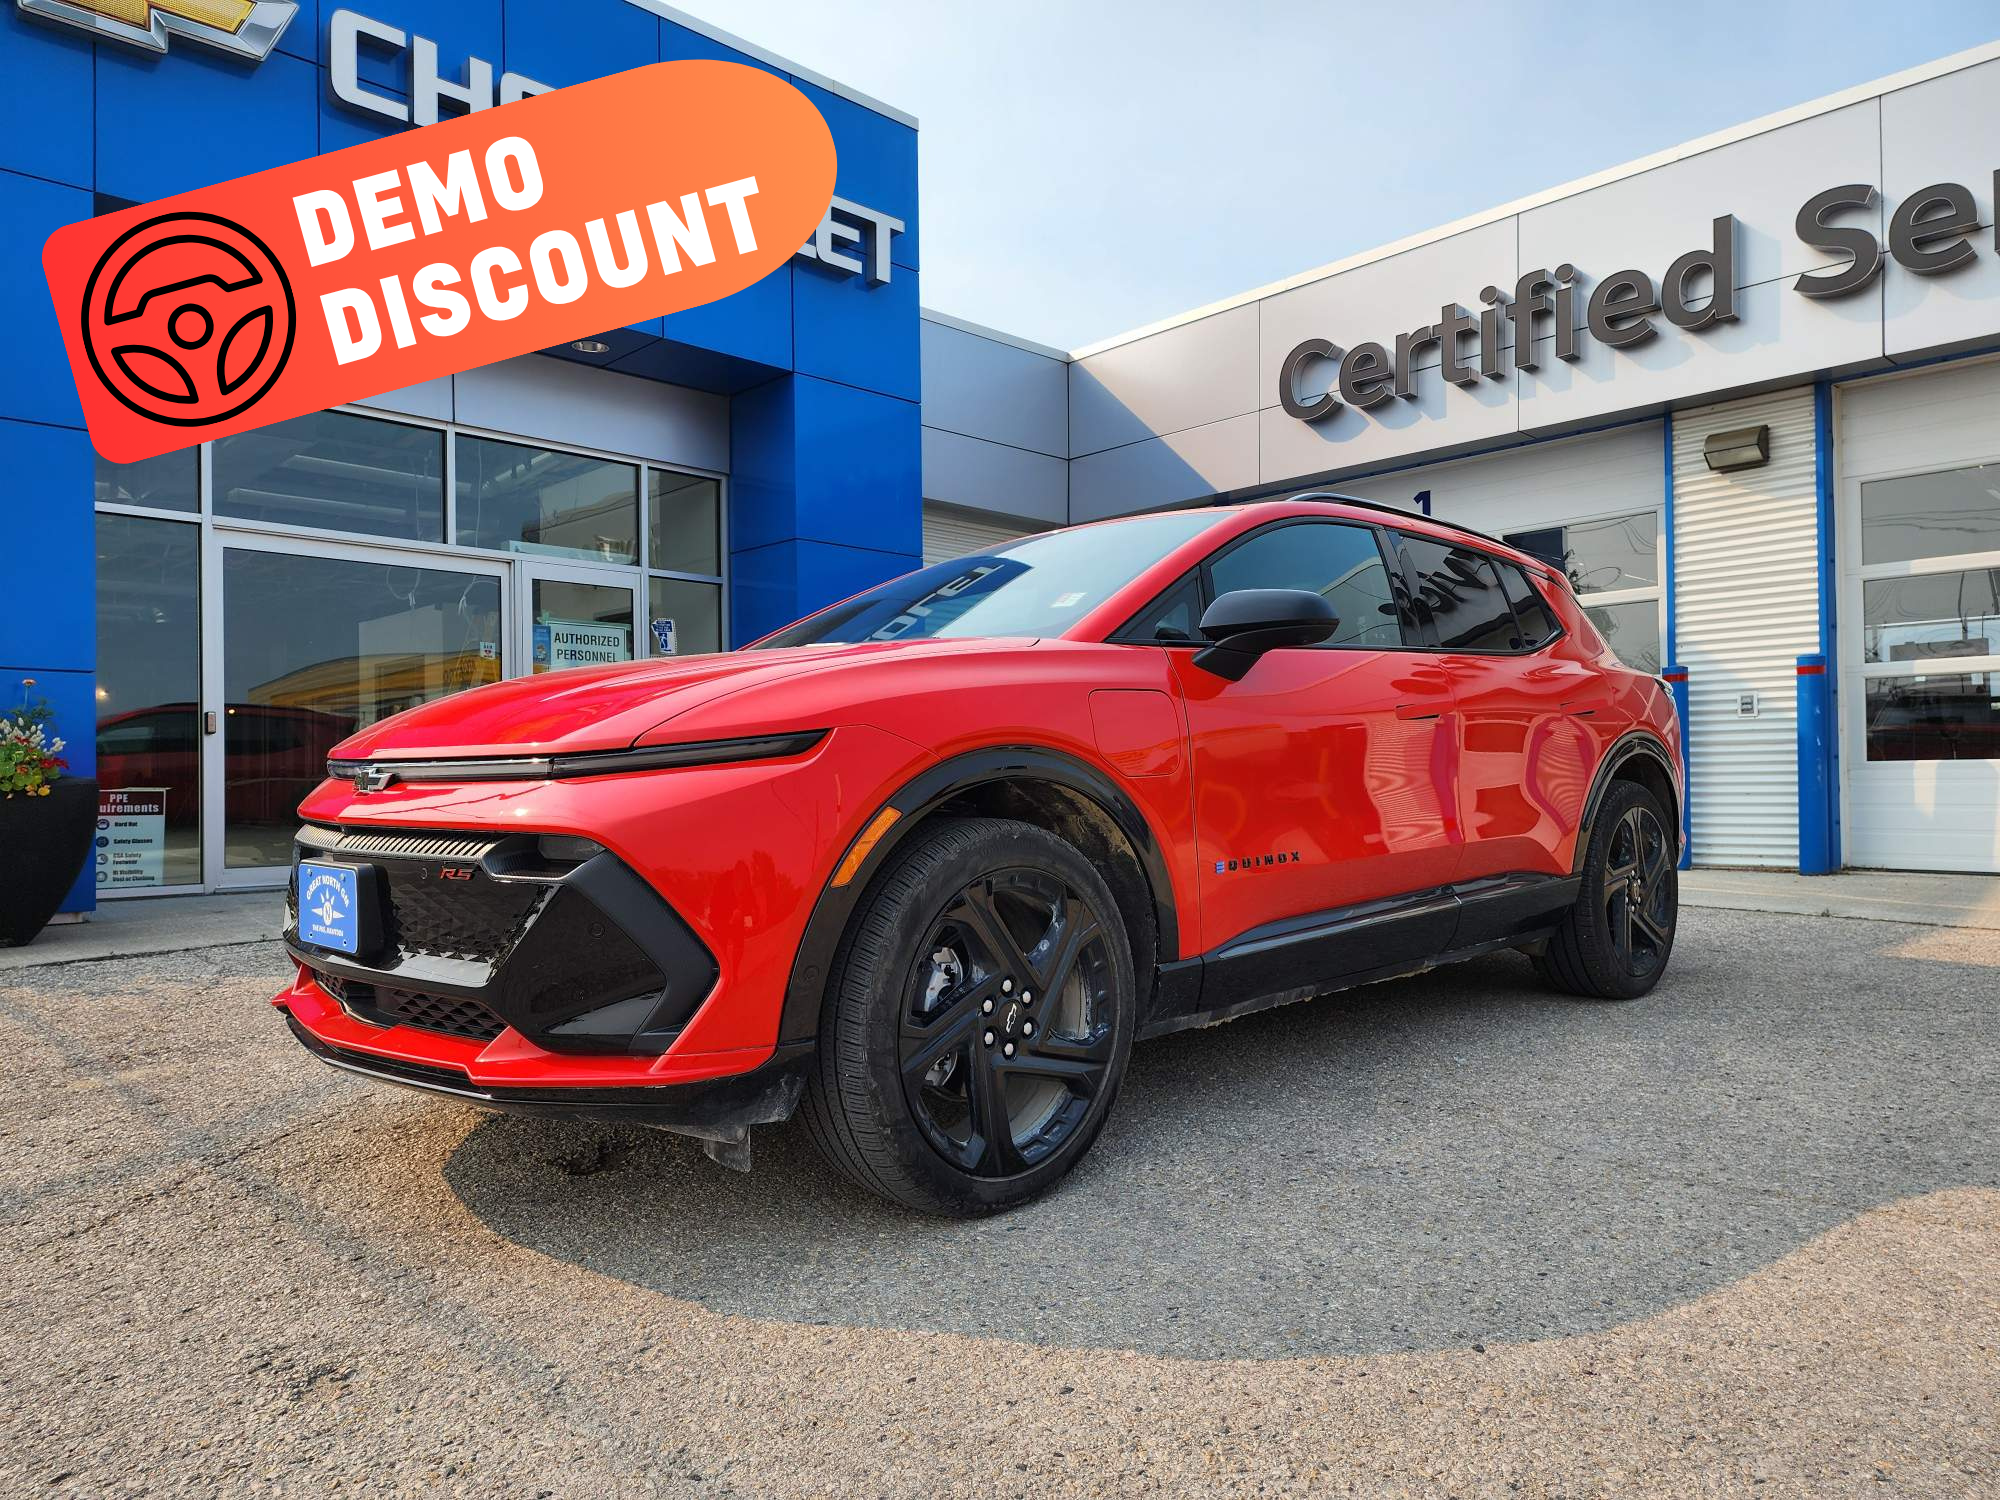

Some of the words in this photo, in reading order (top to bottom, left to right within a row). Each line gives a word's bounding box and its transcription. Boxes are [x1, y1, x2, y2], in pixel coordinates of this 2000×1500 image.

[1279, 214, 1738, 420] Certified
[1793, 168, 2000, 298] Se
[1413, 490, 1431, 516] 1
[554, 632, 620, 647] AUTHORIZED
[556, 650, 617, 663] PERSONNEL
[109, 793, 129, 803] PPE
[99, 803, 160, 813] uirements
[1215, 851, 1299, 875] EQUINOX
[440, 866, 473, 880] RS
[306, 875, 322, 900] GREAT
[322, 875, 341, 892] NORTH
